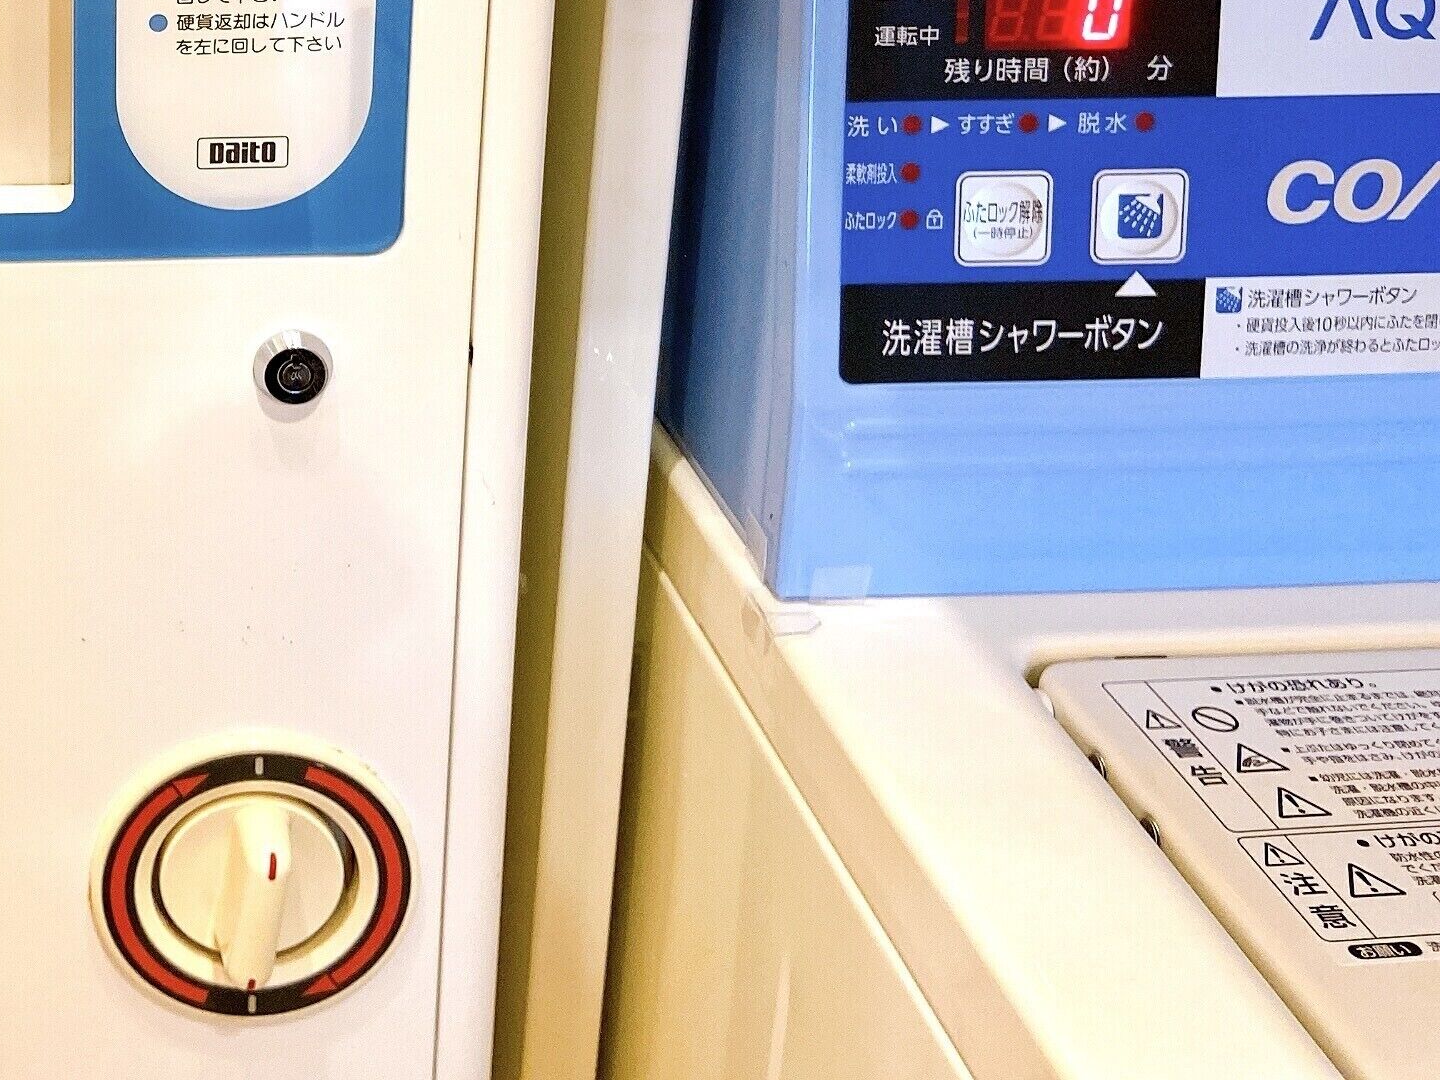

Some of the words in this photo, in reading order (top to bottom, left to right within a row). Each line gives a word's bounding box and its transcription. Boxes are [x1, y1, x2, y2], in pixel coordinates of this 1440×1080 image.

[176, 10, 346, 32] 硬貨返却はハンドル
[175, 34, 343, 56] を左に回して下さい
[874, 25, 940, 48] 運転中
[1146, 55, 1174, 82] 分
[958, 112, 1015, 135] すすぎ
[844, 211, 898, 231] ふたロック
[963, 199, 1043, 224] ふたロック解除
[1248, 285, 1418, 308] 洗濯槽シャワーボタン
[881, 313, 1164, 358] 洗濯槽シャワーボタン
[1161, 737, 1228, 787] 警告
[1279, 872, 1357, 929] 注意
